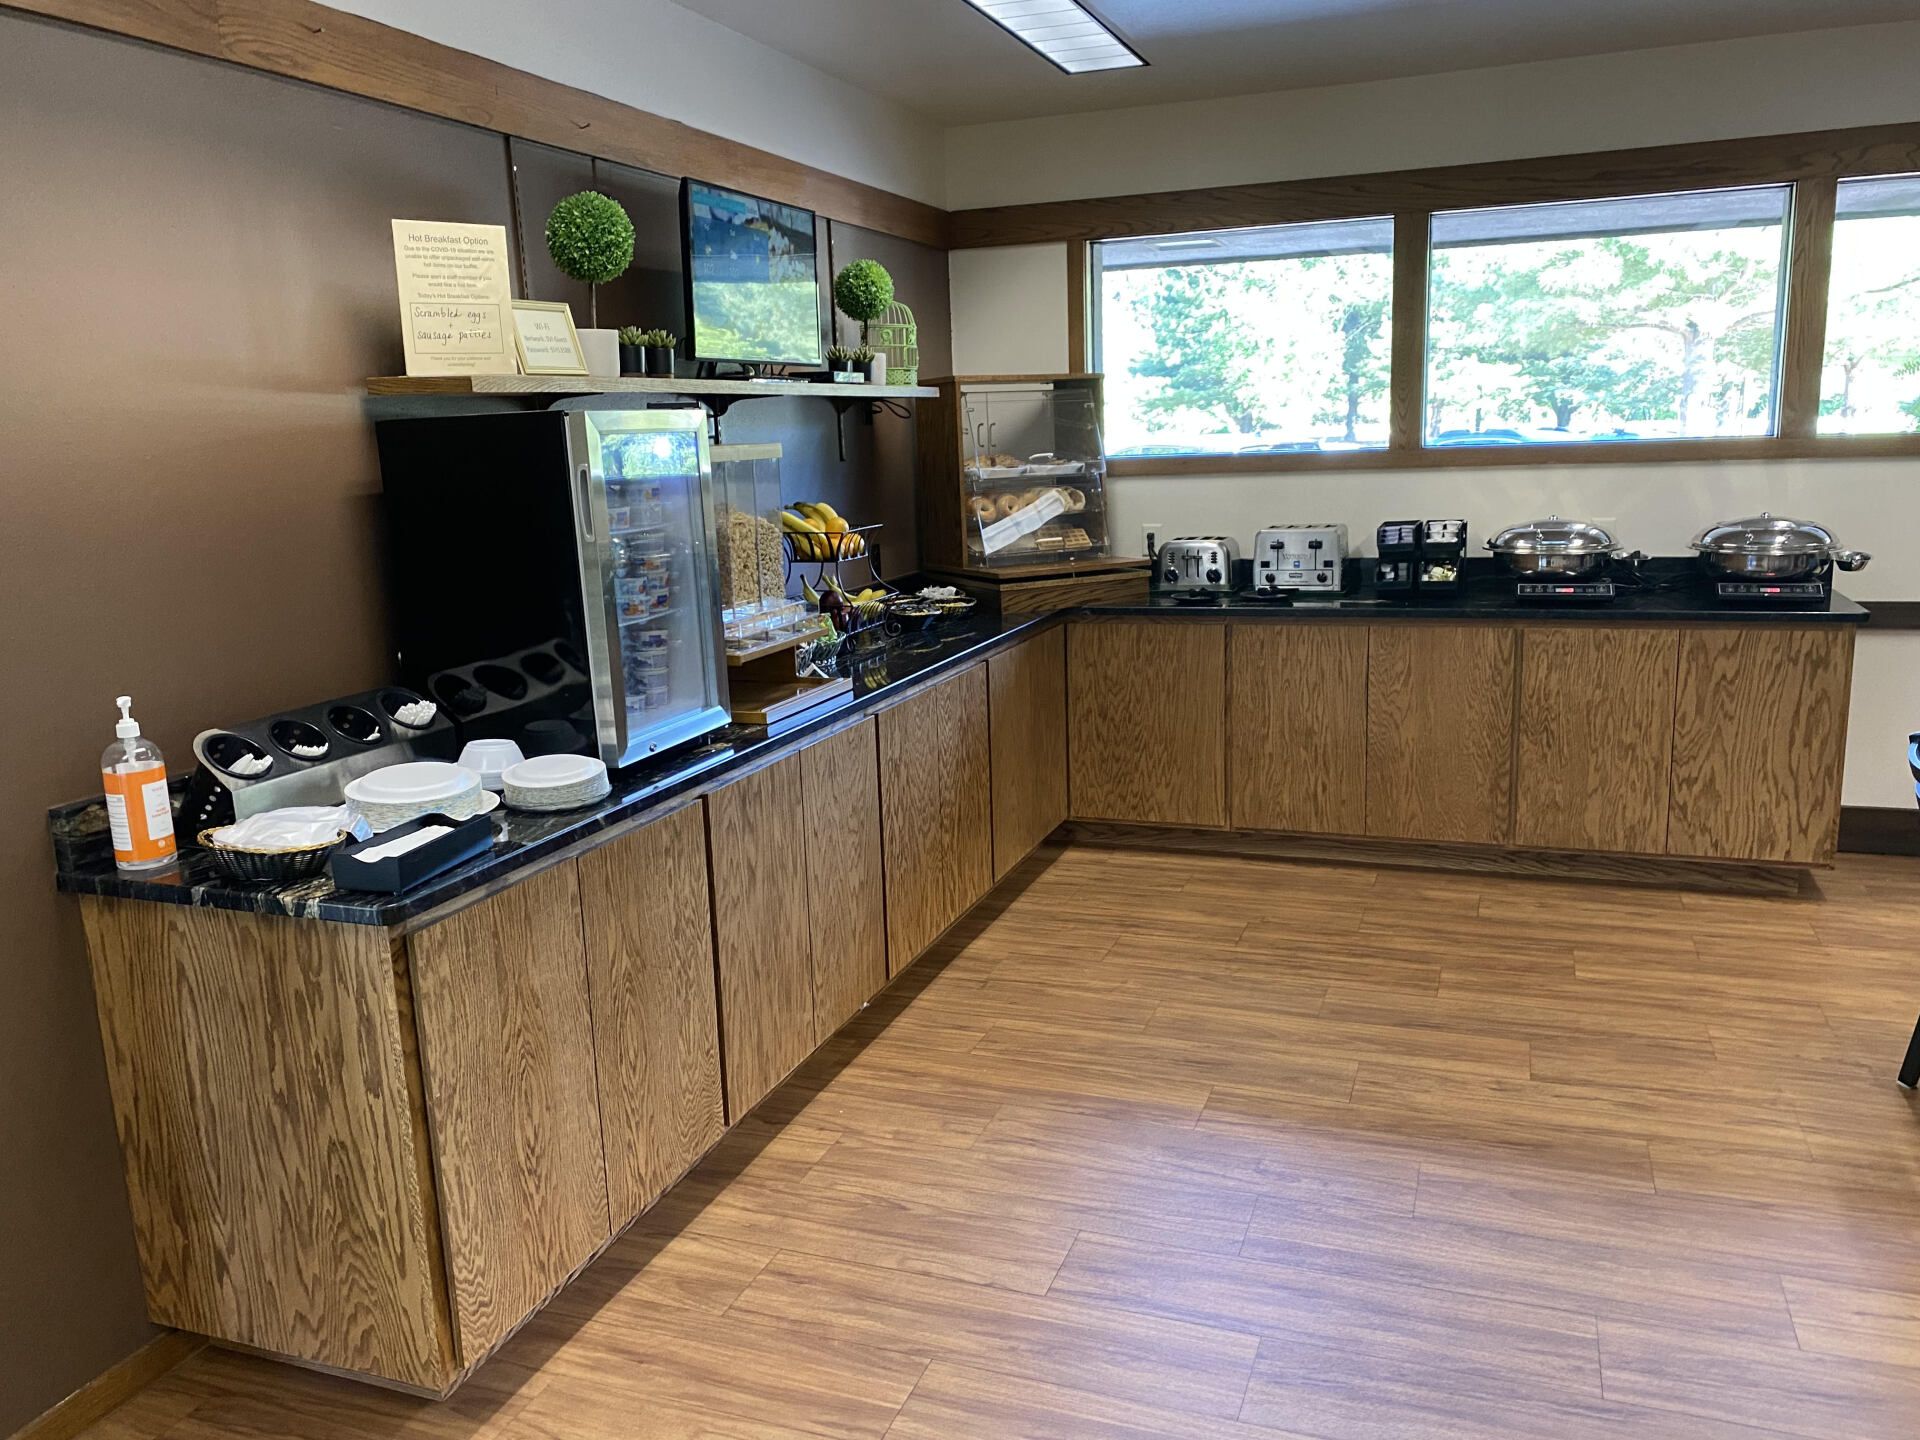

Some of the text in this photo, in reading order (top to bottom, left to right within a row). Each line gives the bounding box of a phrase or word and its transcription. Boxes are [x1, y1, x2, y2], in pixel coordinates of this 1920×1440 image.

[408, 233, 488, 246] Hot Breakfast Option
[414, 306, 486, 324] Scrambled eggs
[459, 328, 492, 344] patties
